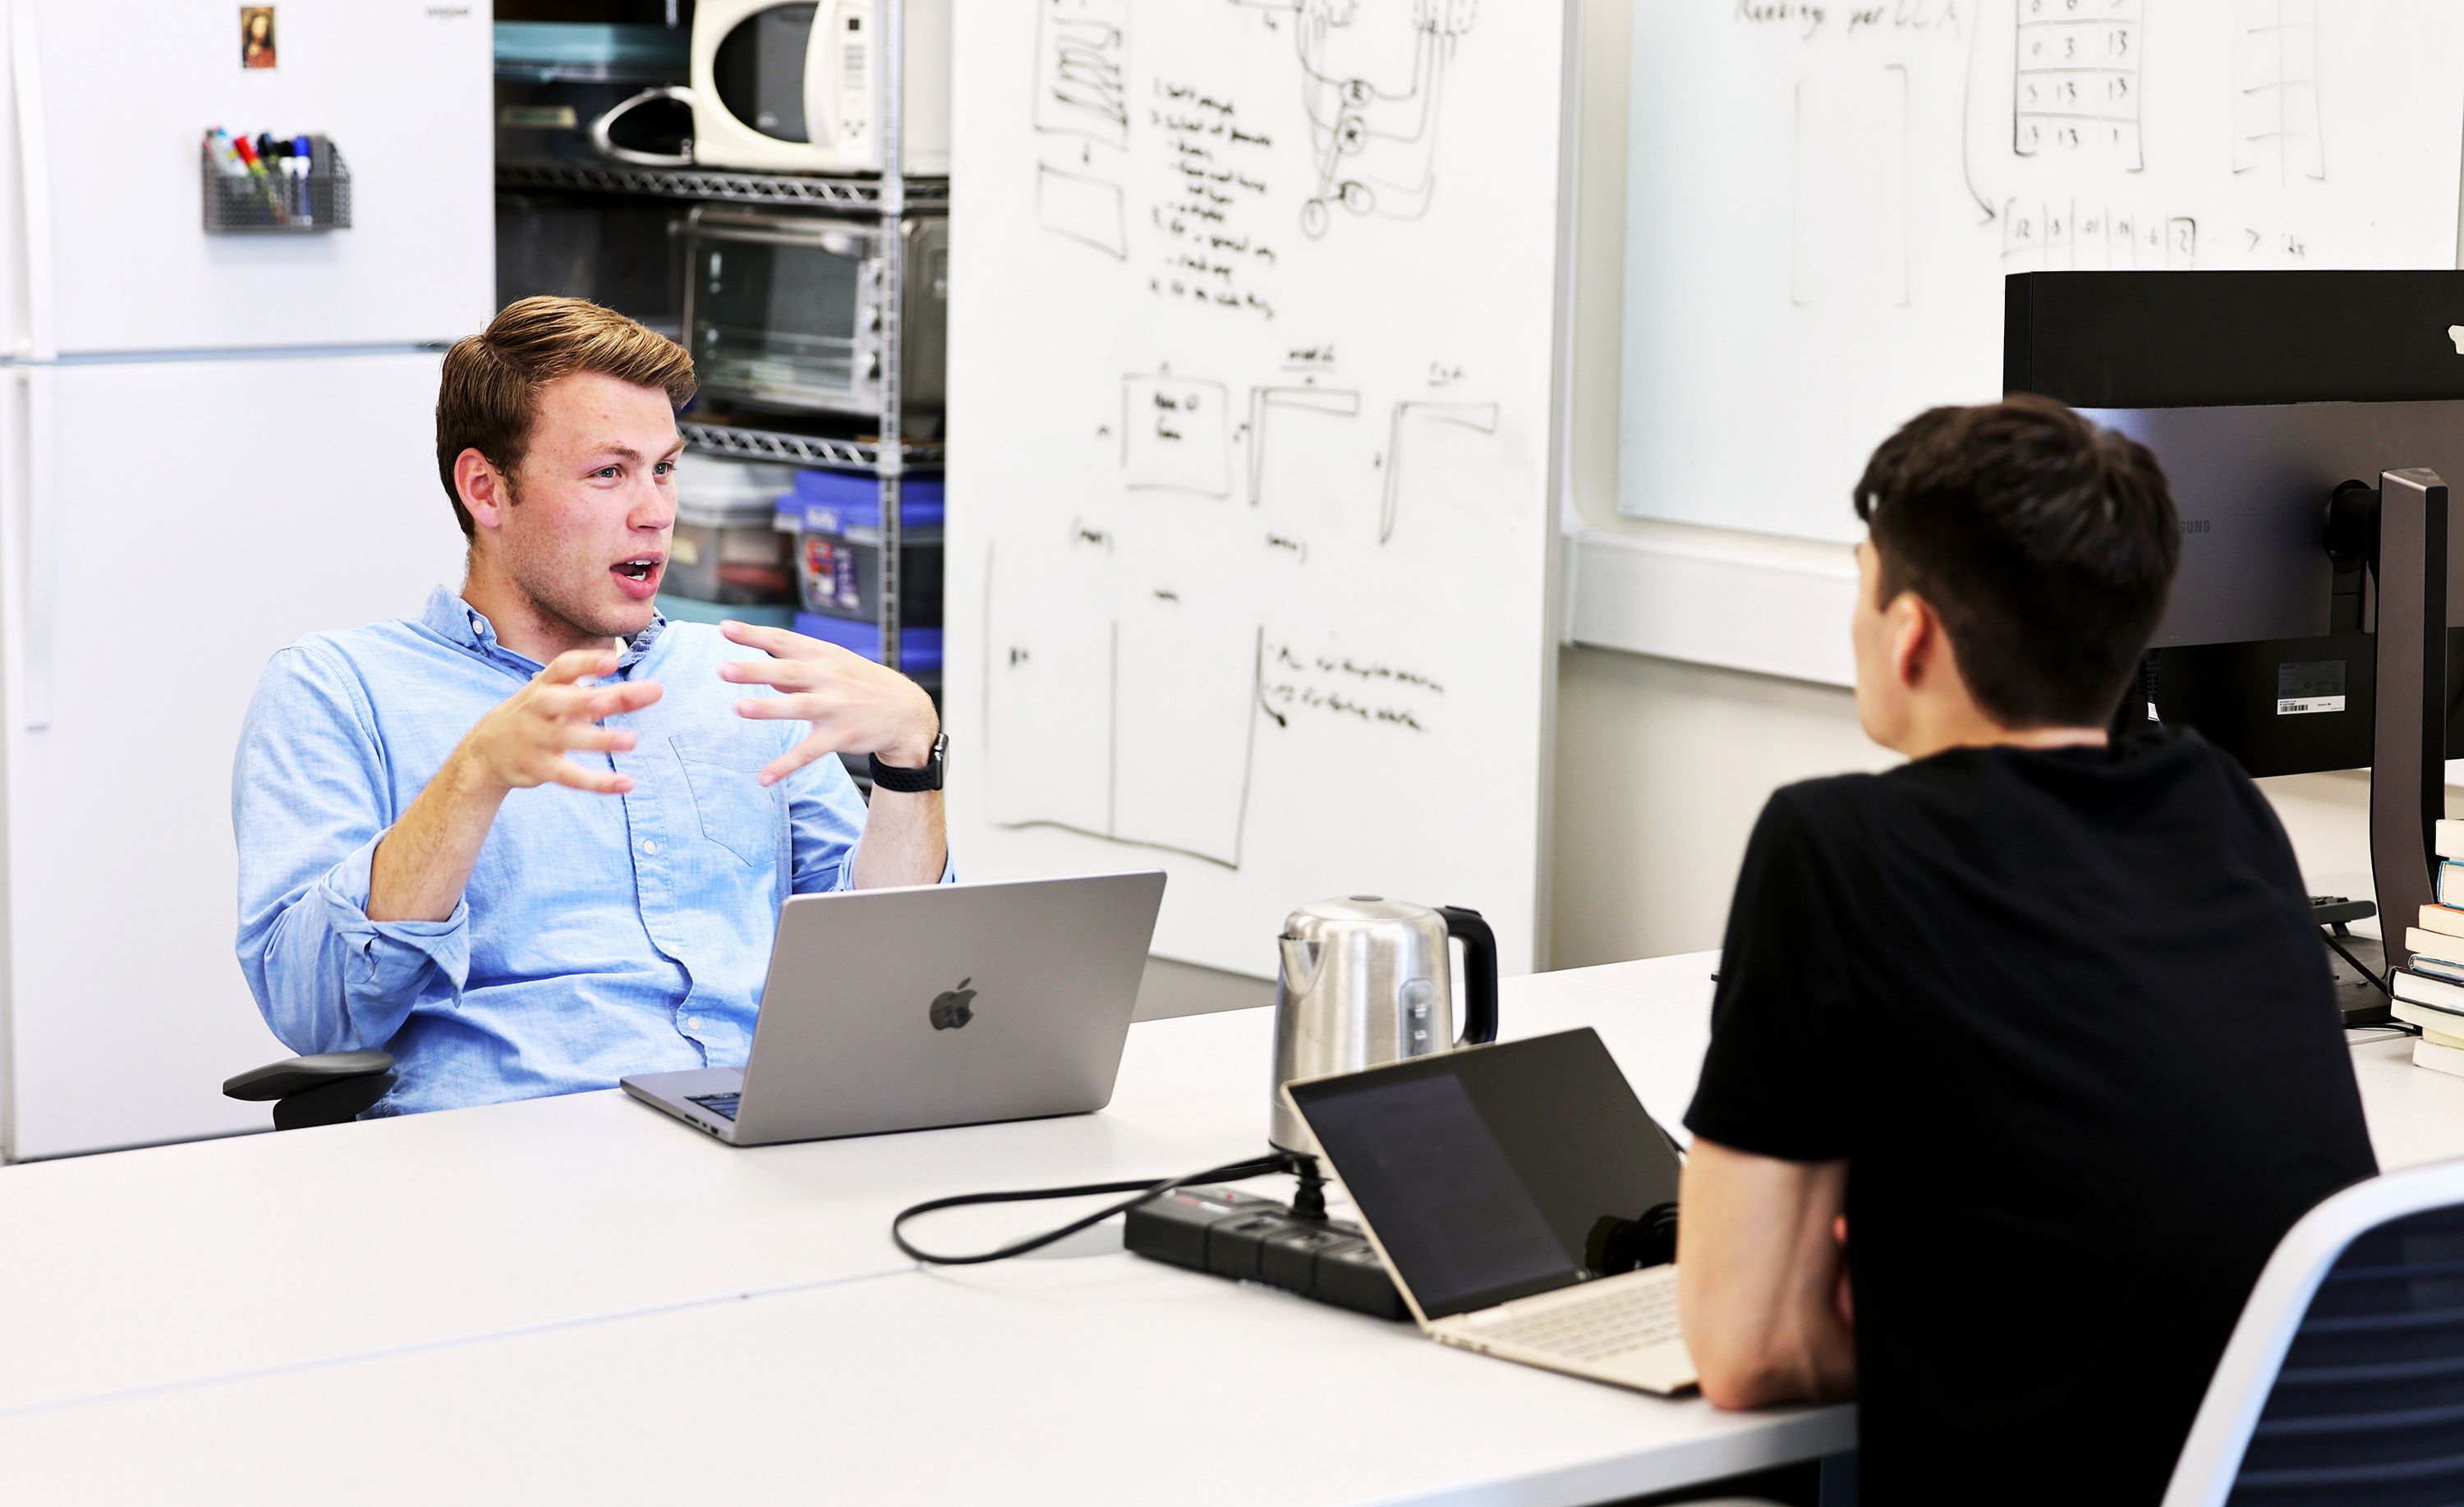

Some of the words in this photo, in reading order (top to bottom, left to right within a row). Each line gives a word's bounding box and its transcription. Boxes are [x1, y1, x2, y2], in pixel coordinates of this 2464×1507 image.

[2064, 35, 2075, 58] 3
[2108, 30, 2127, 57] 13
[2056, 80, 2076, 104] 13
[2108, 76, 2128, 100] 13
[2057, 126, 2079, 149] 13
[2181, 519, 2209, 534] SUNG
